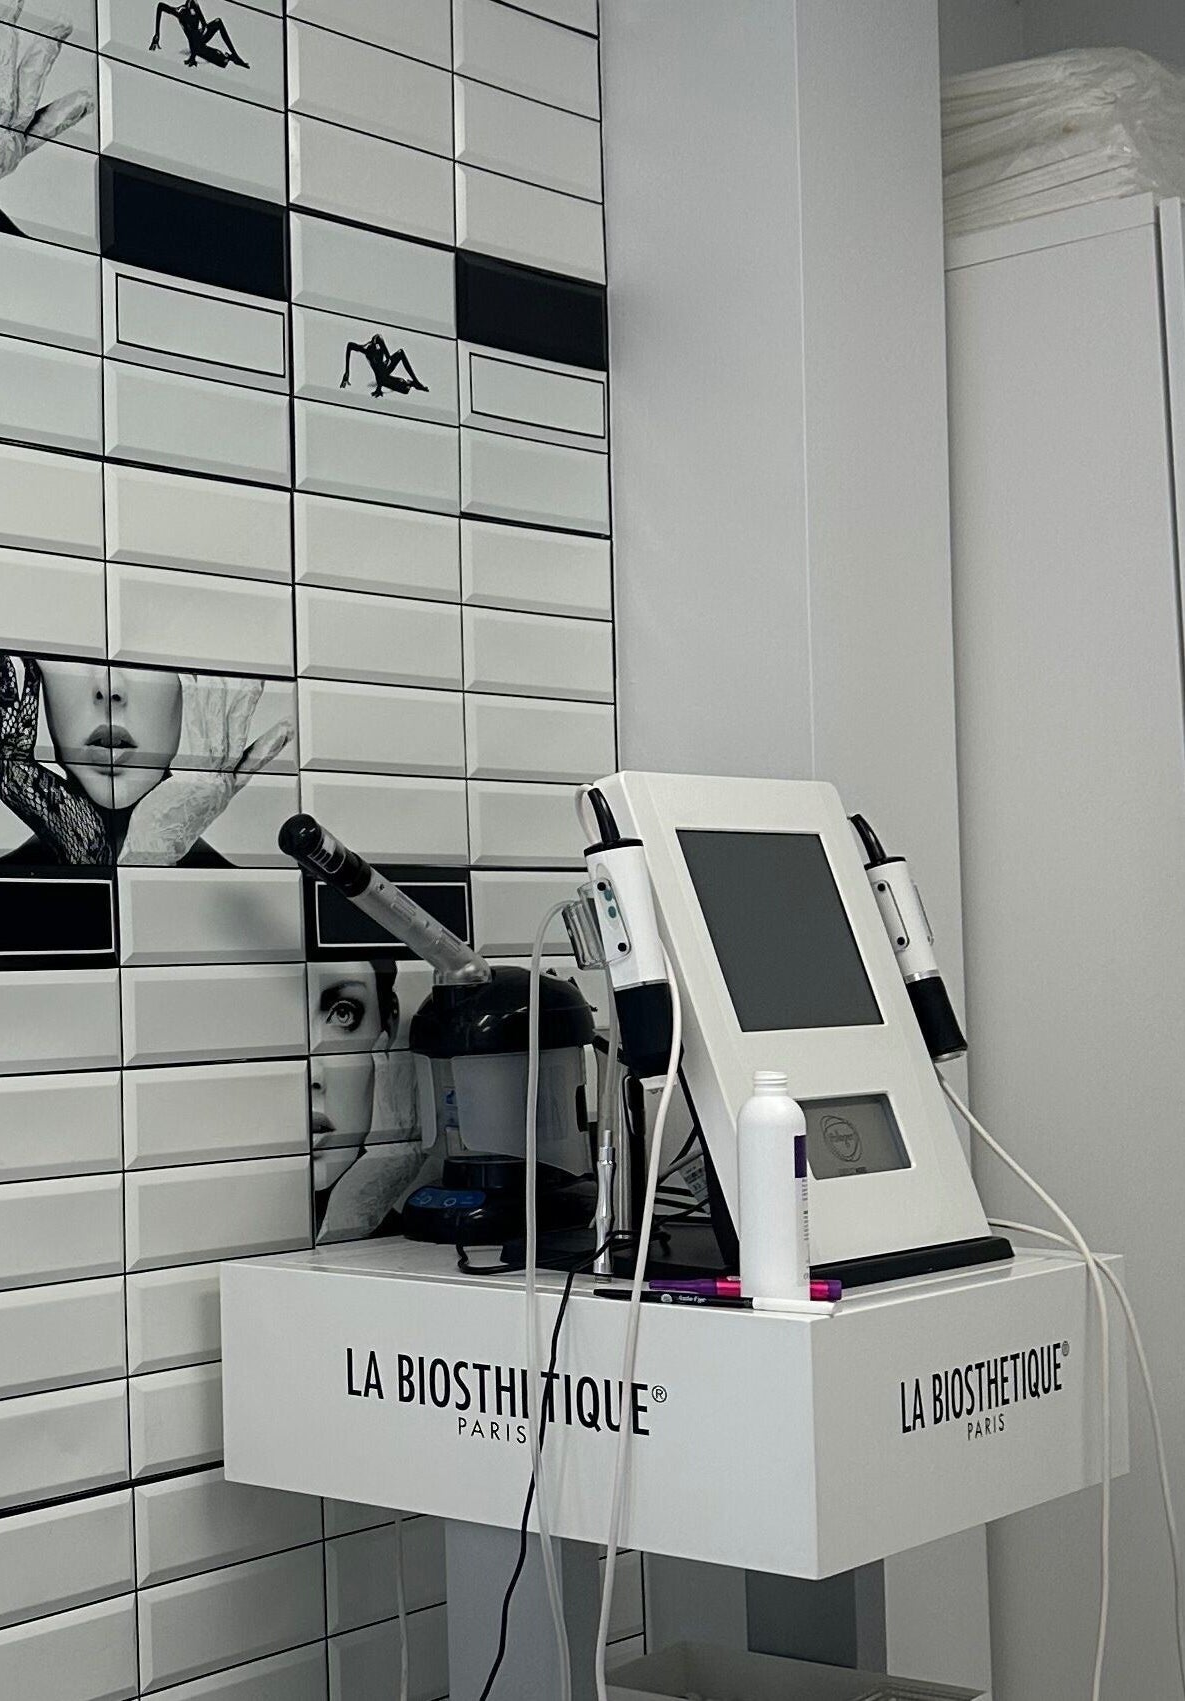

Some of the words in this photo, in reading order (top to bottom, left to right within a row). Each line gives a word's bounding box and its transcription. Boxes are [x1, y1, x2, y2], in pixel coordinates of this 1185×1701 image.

[347, 1347, 384, 1400] LA
[900, 1377, 926, 1434] LA
[457, 1416, 527, 1444] PARIS
[967, 1413, 1005, 1441] PARIS
